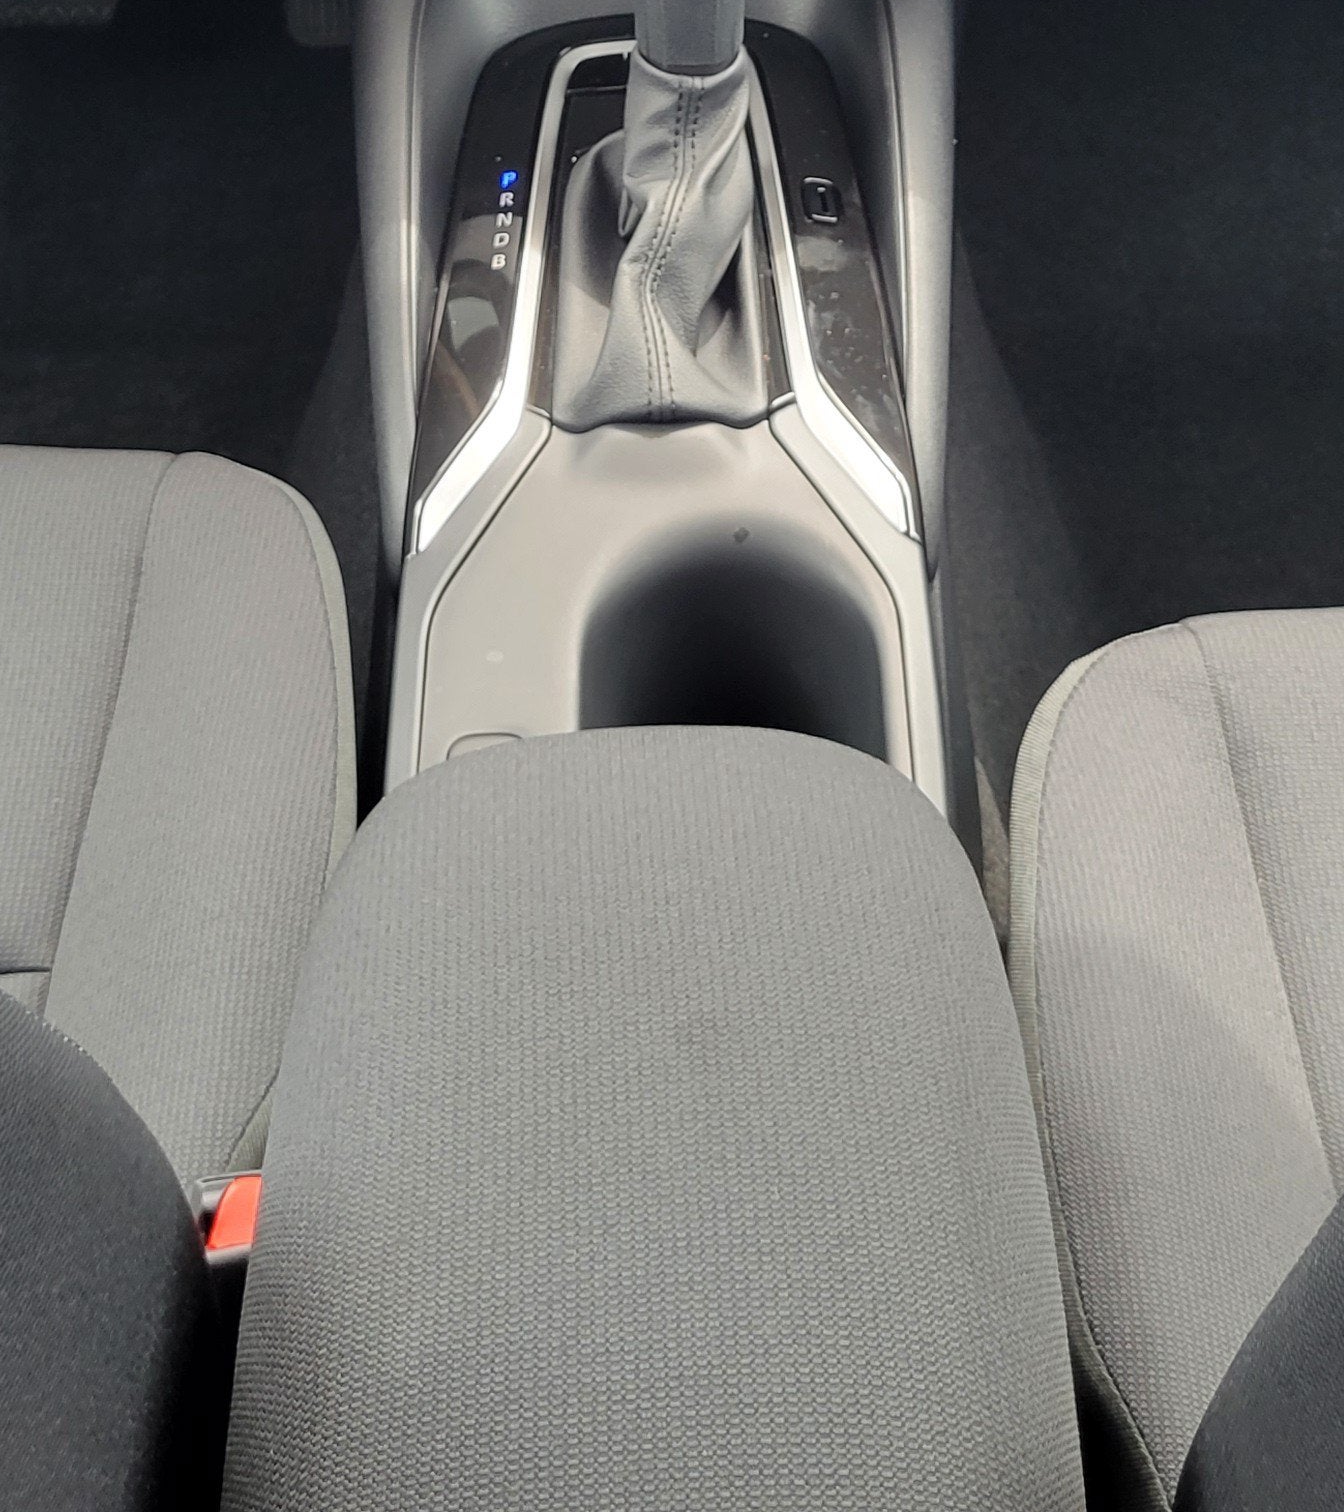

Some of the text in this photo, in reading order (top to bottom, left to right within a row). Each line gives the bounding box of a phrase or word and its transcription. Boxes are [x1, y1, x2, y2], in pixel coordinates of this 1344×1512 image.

[501, 172, 517, 188] P
[499, 191, 515, 207] R
[496, 211, 513, 228] N
[493, 232, 510, 248] D
[490, 253, 507, 270] B
